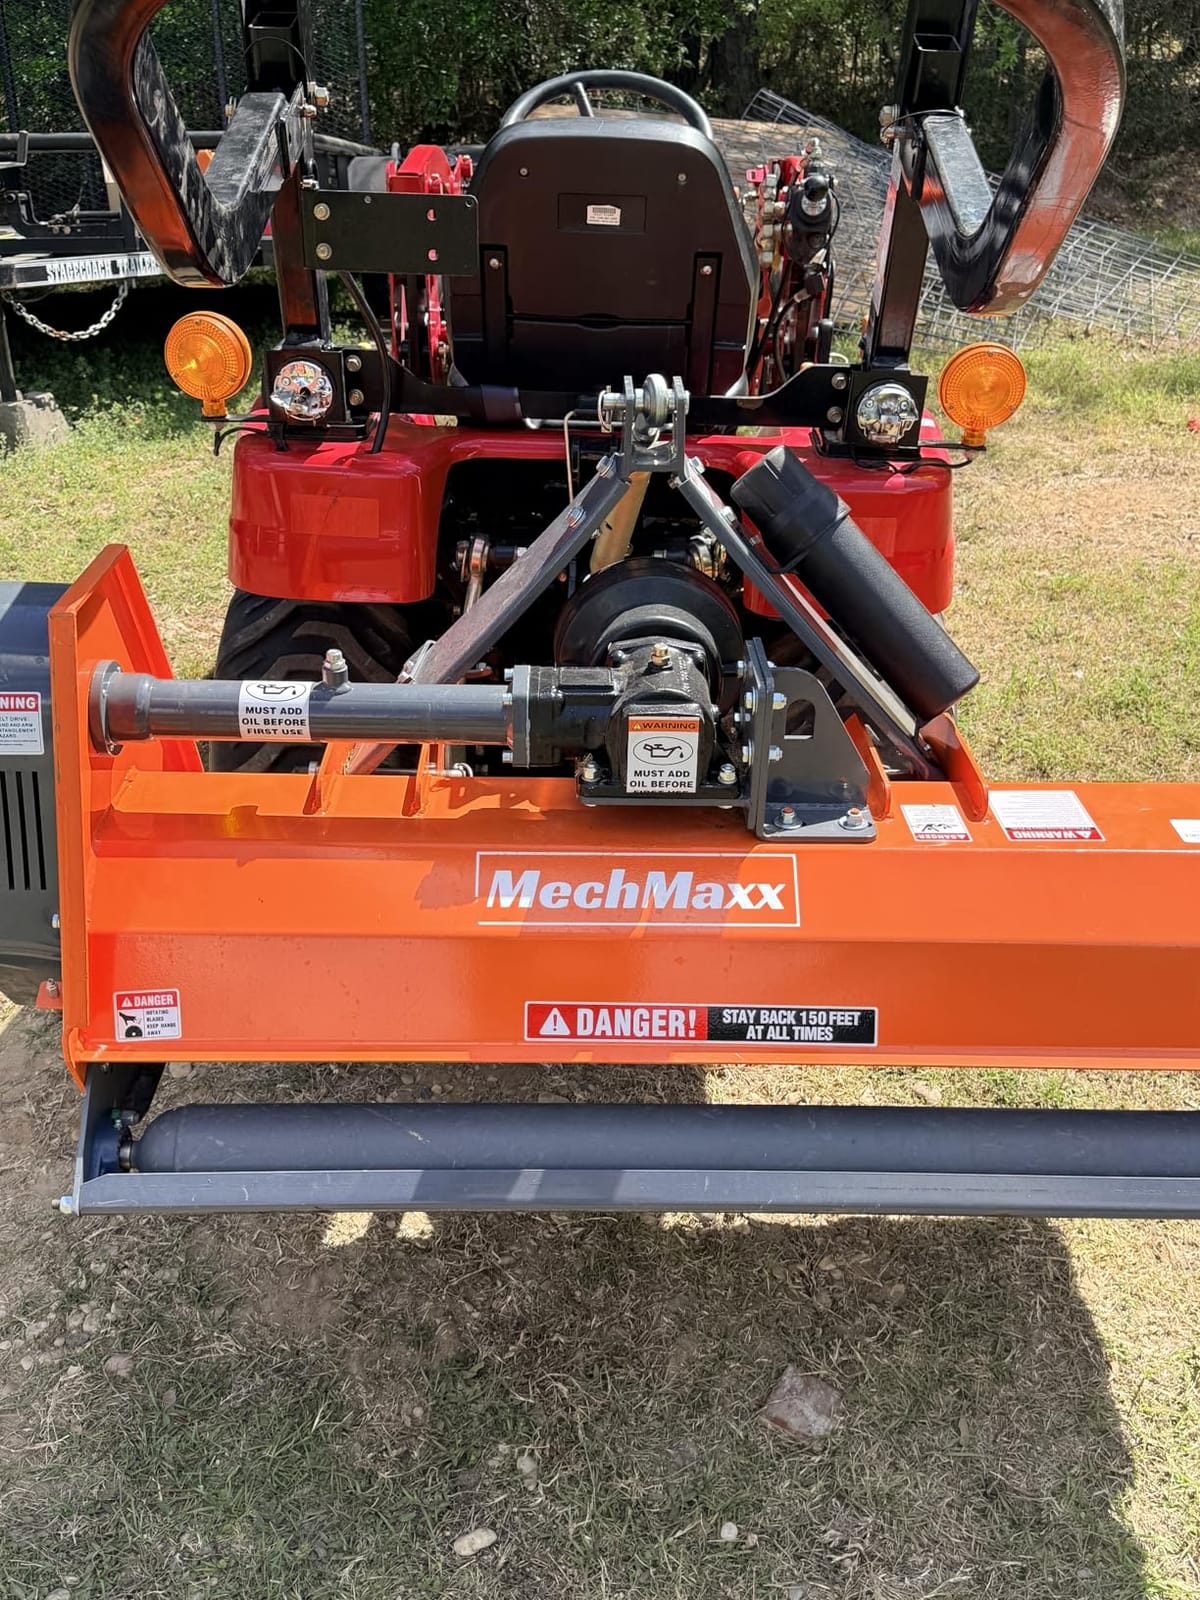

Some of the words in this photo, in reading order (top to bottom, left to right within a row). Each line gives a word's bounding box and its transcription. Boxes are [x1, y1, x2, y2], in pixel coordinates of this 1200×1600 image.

[46, 259, 112, 283] STAGECOACH
[280, 707, 303, 715] ADD
[263, 718, 307, 726] BEFORE
[1011, 831, 1077, 839] WARNING
[486, 868, 786, 910] MechMaxx
[133, 994, 174, 1007] DANGER
[576, 1007, 696, 1038] DANGER!
[722, 1008, 756, 1024] STAY
[760, 1009, 796, 1025] BACK
[800, 1010, 827, 1025] 150
[829, 1011, 861, 1026] FEET
[746, 1025, 764, 1040] AT
[766, 1025, 790, 1040] ALL
[792, 1026, 834, 1041] TIMES
